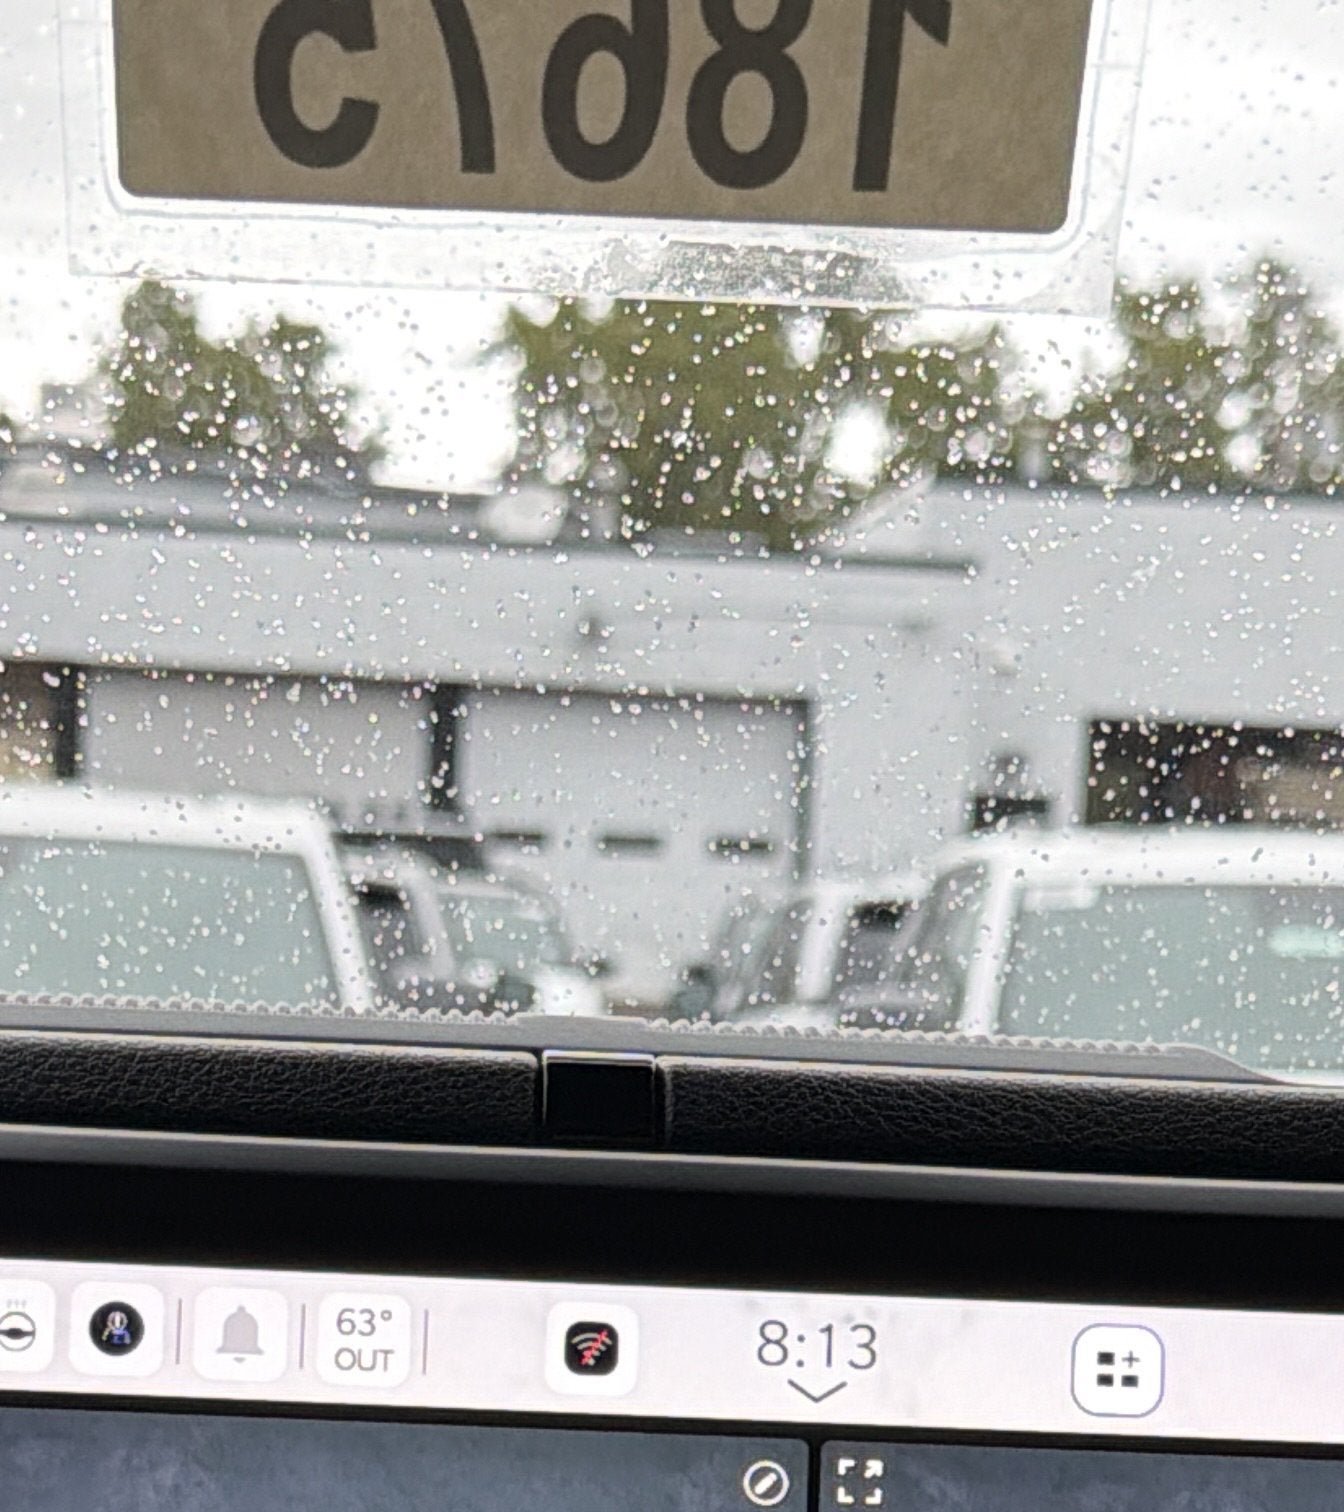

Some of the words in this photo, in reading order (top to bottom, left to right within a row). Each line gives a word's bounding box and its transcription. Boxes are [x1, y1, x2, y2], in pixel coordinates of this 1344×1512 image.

[336, 1307, 394, 1338] 63°
[334, 1347, 395, 1373] OUT
[757, 1319, 877, 1370] 8:13
